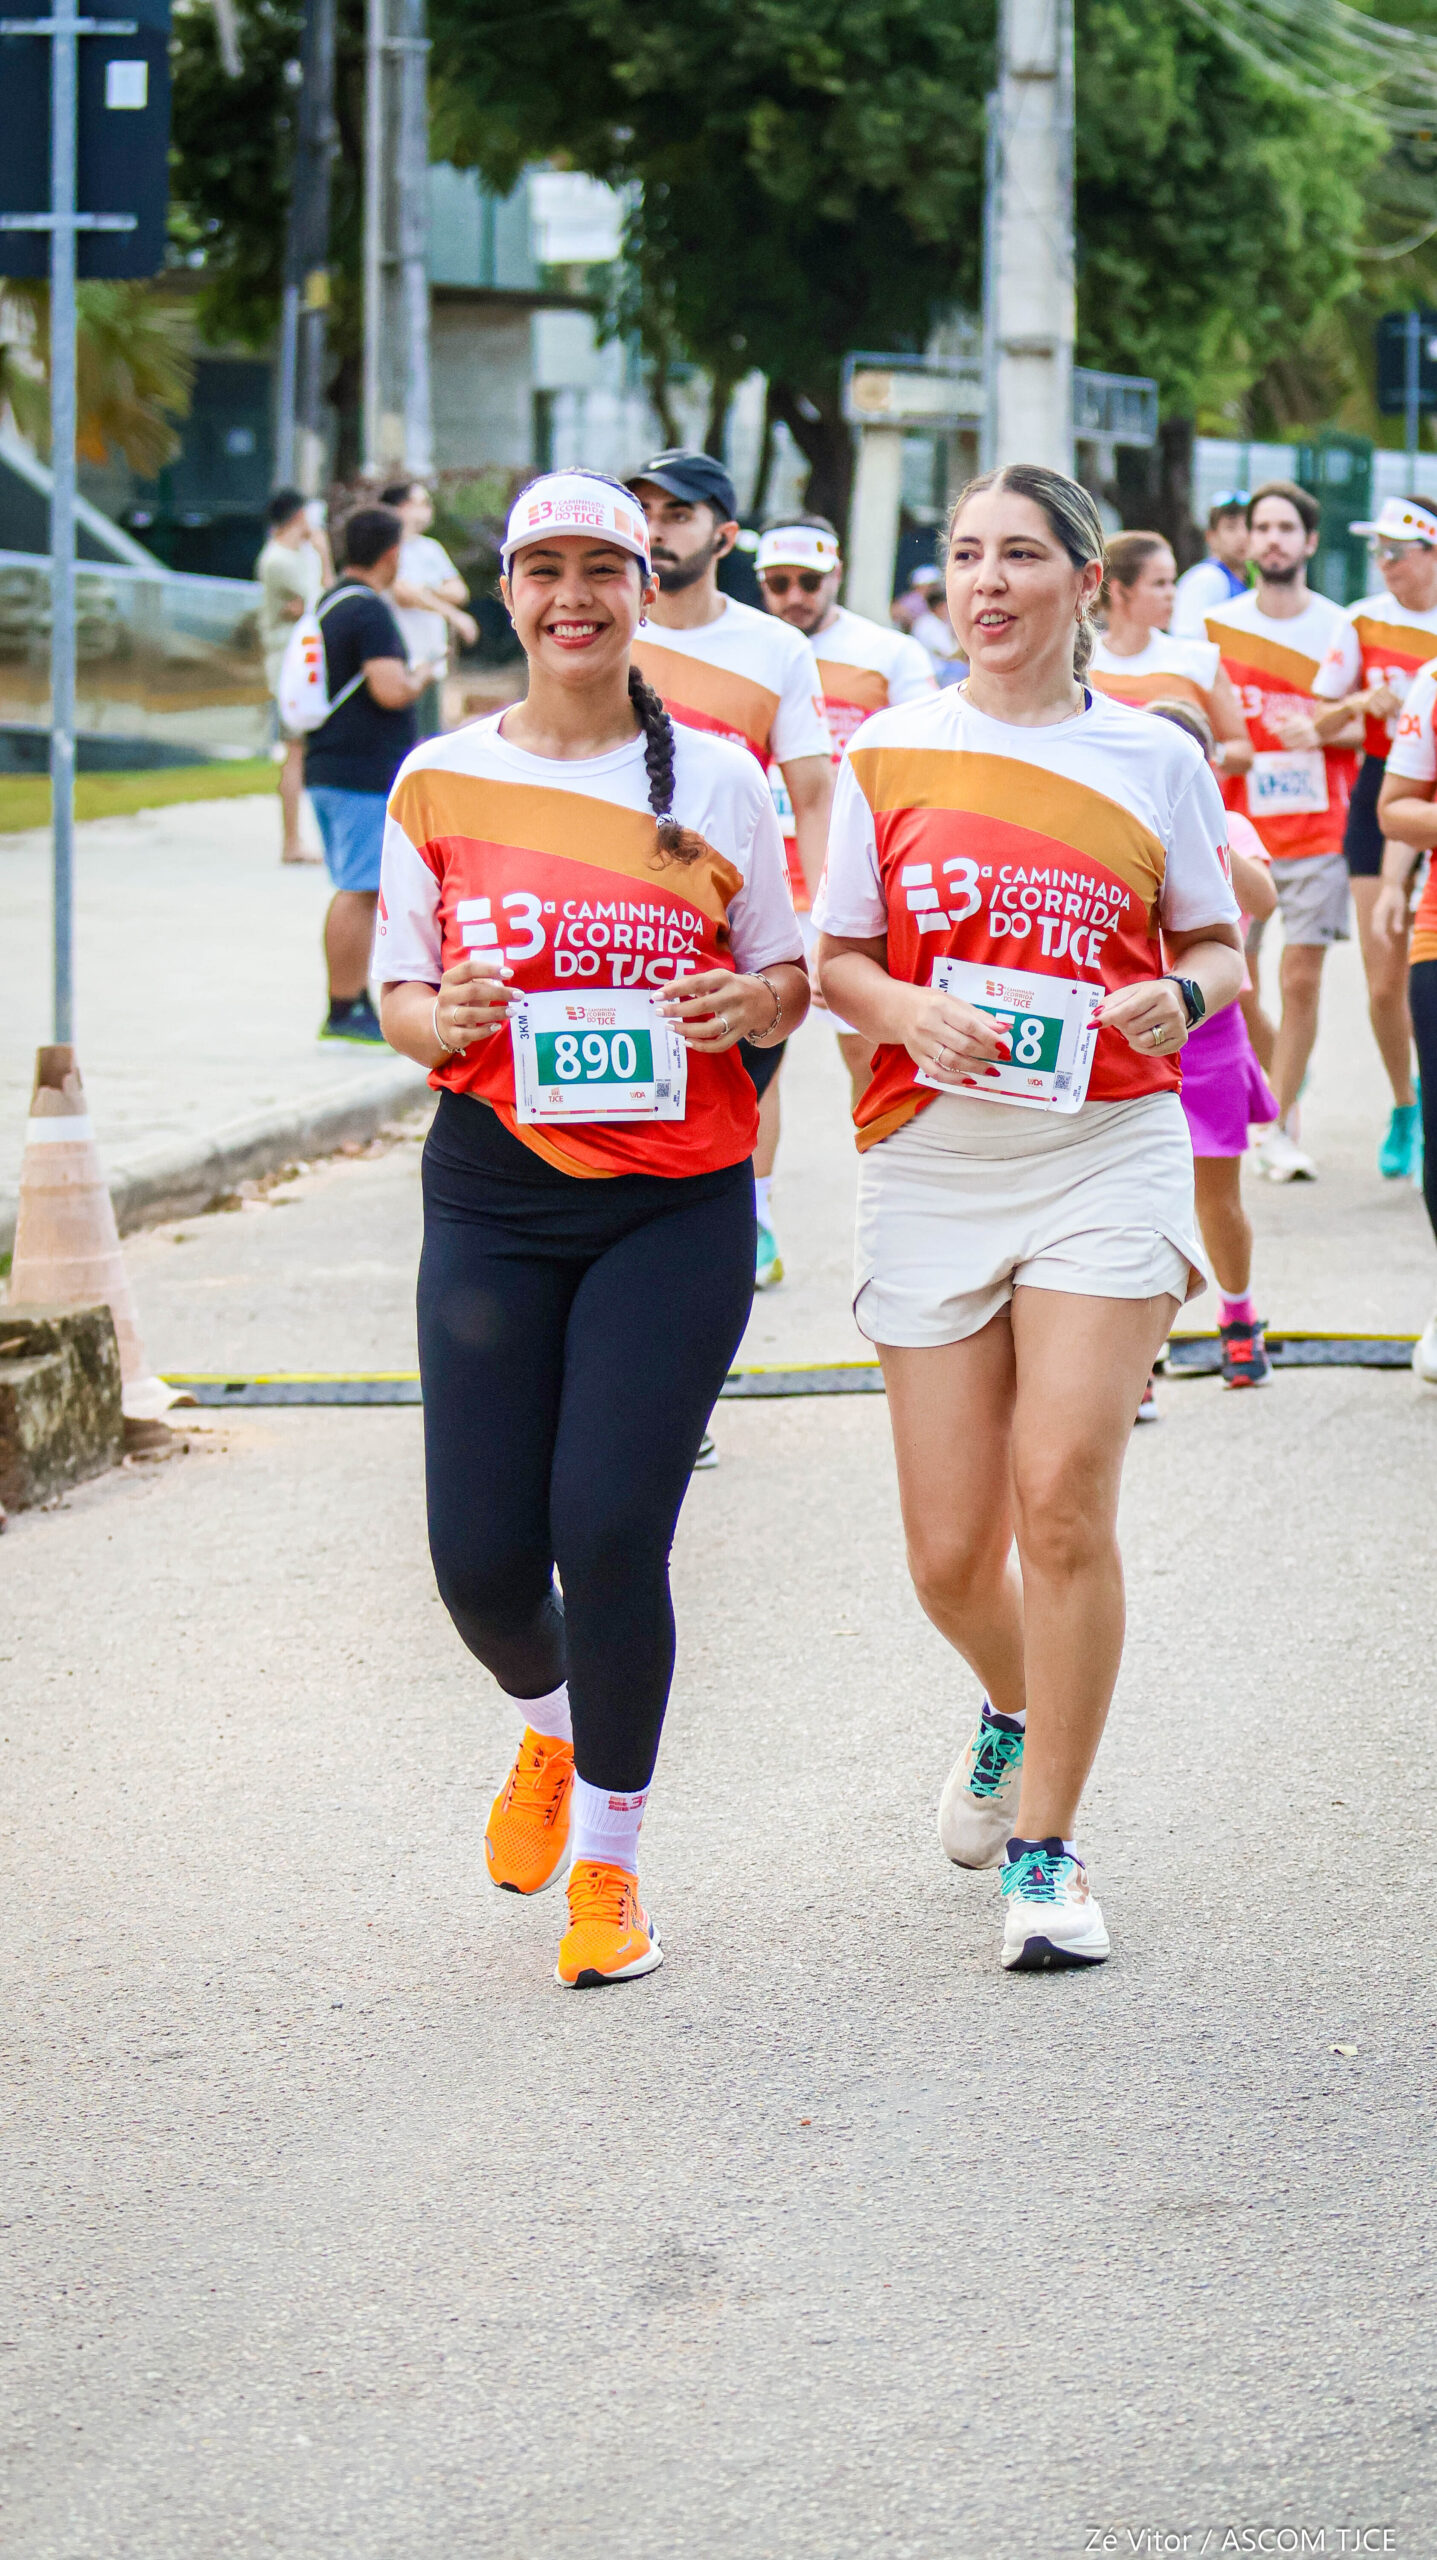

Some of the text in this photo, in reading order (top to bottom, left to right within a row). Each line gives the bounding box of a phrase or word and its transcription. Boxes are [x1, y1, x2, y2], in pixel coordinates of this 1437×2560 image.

[555, 512, 604, 526] DO TJCE
[999, 865, 1131, 911] CAMINHADA
[562, 900, 704, 936] CAMINHADA
[989, 911, 1109, 970] DO TJCE
[554, 950, 601, 978] DO
[1013, 998, 1032, 1009] TJCE
[518, 1014, 530, 1040] 3KM
[597, 1017, 616, 1025] TJCE
[554, 1032, 637, 1080] 890
[548, 1095, 564, 1103] TJCE
